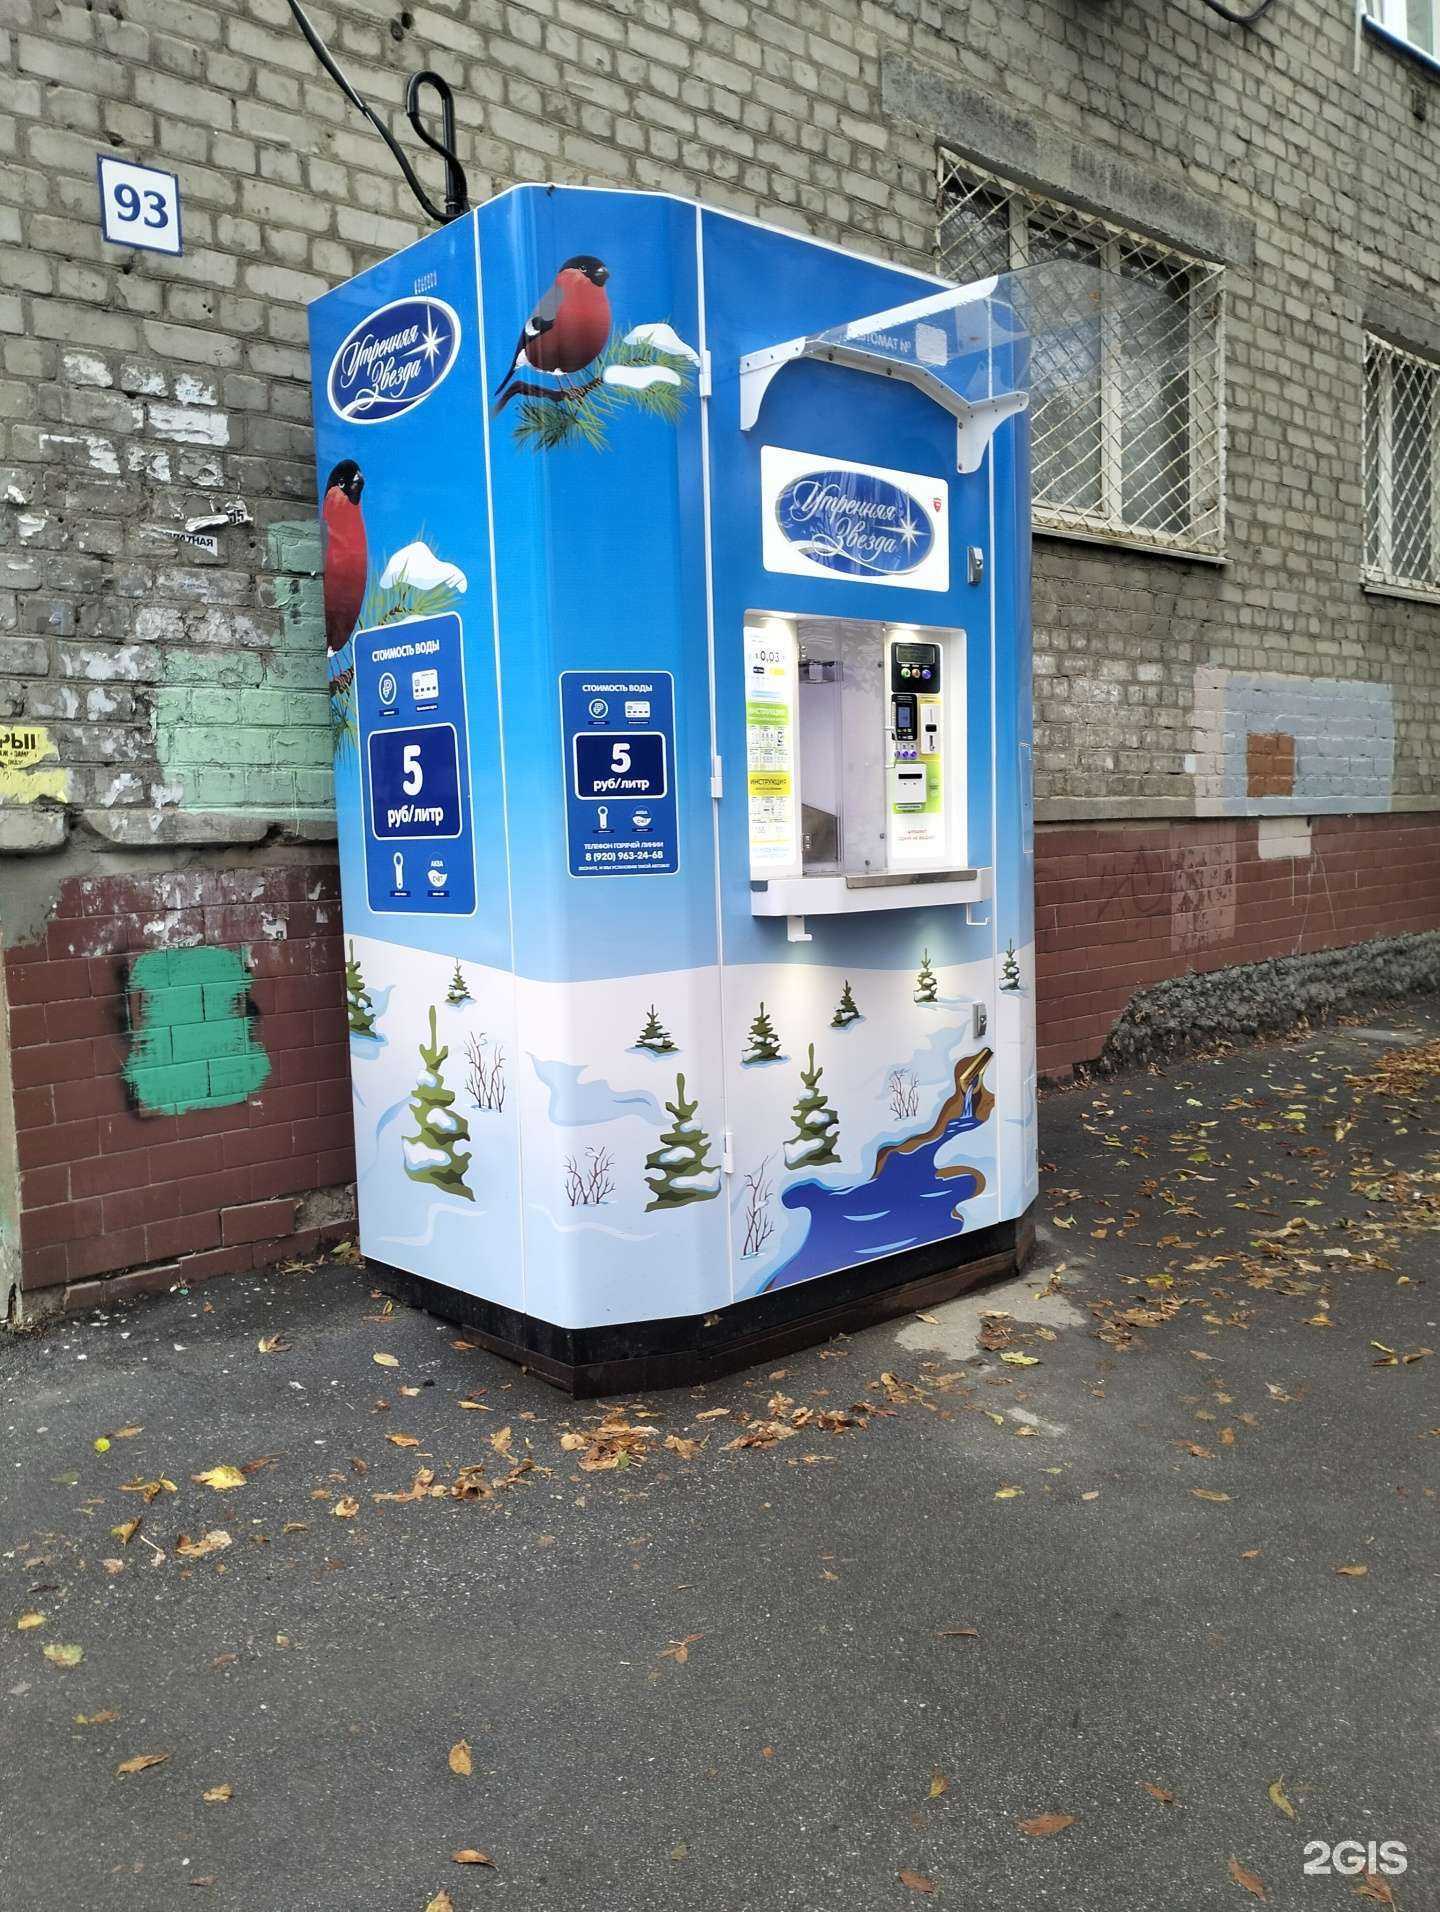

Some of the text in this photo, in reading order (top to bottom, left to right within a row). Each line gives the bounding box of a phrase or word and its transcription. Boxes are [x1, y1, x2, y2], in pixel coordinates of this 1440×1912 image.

[113, 182, 169, 229] 93
[341, 324, 420, 388] Утренняя
[356, 357, 422, 410] Звезда
[790, 481, 897, 523] Утренняя
[812, 517, 897, 562] Звезда
[372, 639, 440, 662] СТОИМОСТЬ ВОДЫ
[582, 684, 653, 693] СТОИМОСТЬ ВОДЫ
[402, 744, 424, 796] 5
[610, 742, 632, 774] 5
[593, 778, 650, 792] руб/литр
[387, 805, 444, 828] руб/литр
[585, 850, 663, 862] 8 (920) 963-24-68
